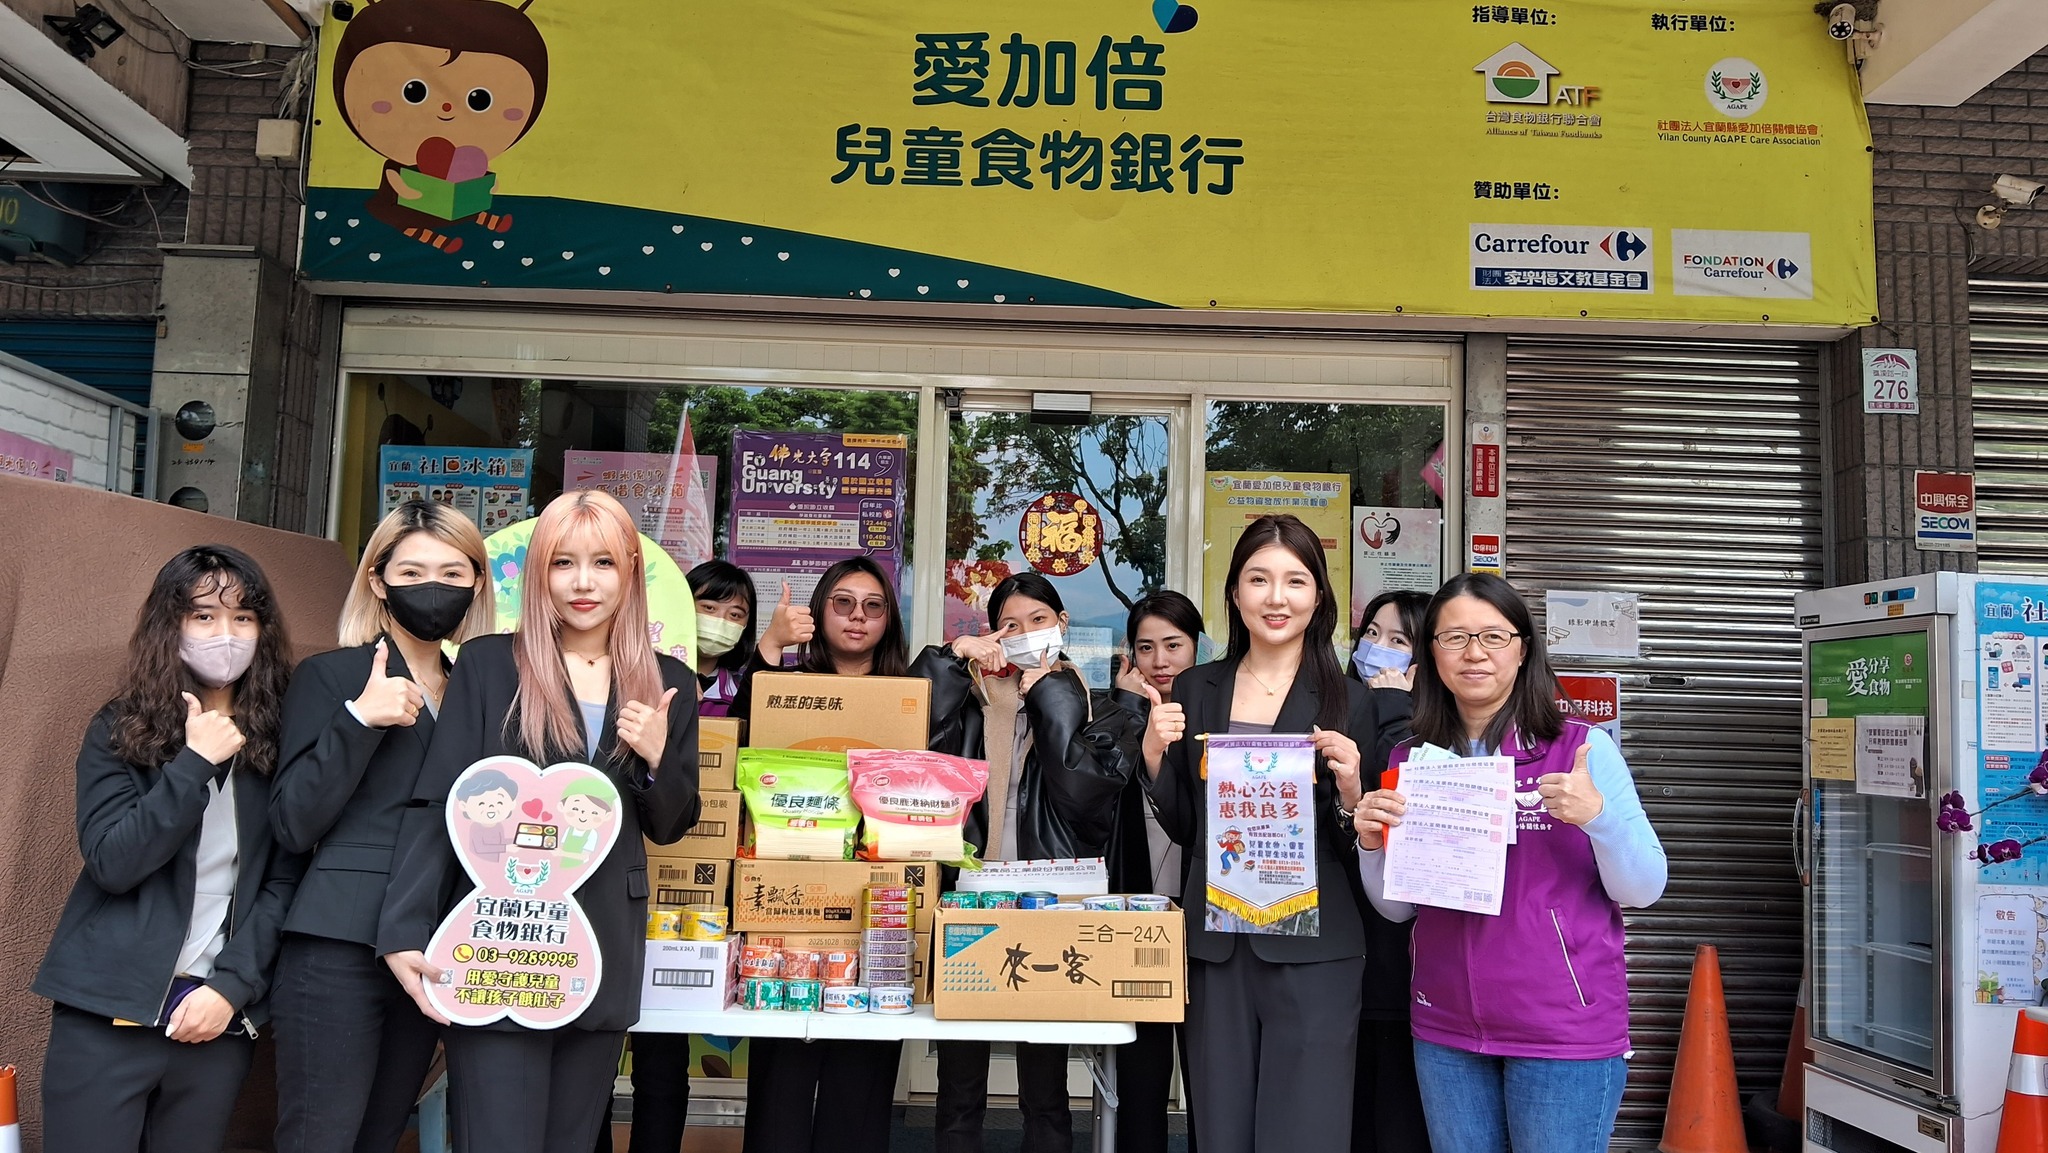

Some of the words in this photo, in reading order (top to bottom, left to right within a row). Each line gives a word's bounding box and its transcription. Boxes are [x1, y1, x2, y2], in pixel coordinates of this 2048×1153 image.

[1471, 5, 1558, 26] 指導單位:
[1651, 13, 1737, 33] 執行單位:
[912, 31, 1166, 111] 愛加倍
[1554, 85, 1600, 106] ATF
[1485, 110, 1602, 127] 台灣食物銀行聯合會
[1657, 119, 1819, 136] 社團法人宜蘭縣愛加倍關懷協會
[1486, 127, 1518, 136] Alliance
[1531, 129, 1559, 138] Taiwan
[1560, 130, 1603, 139] Foodbanks
[1657, 132, 1680, 143] Yilan
[1682, 134, 1711, 145] County
[1713, 135, 1747, 144] AGAPE
[1749, 136, 1770, 145] Care
[1772, 137, 1821, 146] Association
[830, 123, 1245, 196] 兒童食物銀行
[1473, 181, 1559, 201] 贊助單位:
[1474, 233, 1590, 255] Carrefour
[1683, 254, 1764, 268] FONDATION
[1703, 267, 1764, 280] Carrefour
[1873, 379, 1909, 400] 276
[833, 451, 871, 470] 114
[741, 464, 804, 484] Guang
[1920, 492, 1969, 508] 中興保全
[1041, 511, 1083, 553] 福
[1921, 516, 1970, 530] SECOM
[1474, 555, 1498, 563] SECOM
[1868, 656, 1891, 674] 分享
[1846, 657, 1869, 697] 愛
[1868, 678, 1891, 696] 食物
[765, 694, 844, 711] 熟悉的美味
[1217, 780, 1298, 800] 熱心公益
[770, 792, 841, 811] 優良麵條
[1218, 801, 1300, 820] 惠我良多
[473, 896, 571, 922] 宜蘭兒童
[1995, 909, 2017, 921] 敬告
[471, 919, 568, 945] 食物銀行
[1077, 923, 1171, 944] 三合一24入
[476, 947, 579, 968] 03-9289995
[999, 942, 1102, 992] 來一客
[464, 968, 561, 991] 用愛守護兒童
[454, 987, 566, 1009] 不讓孩子餓肚子
